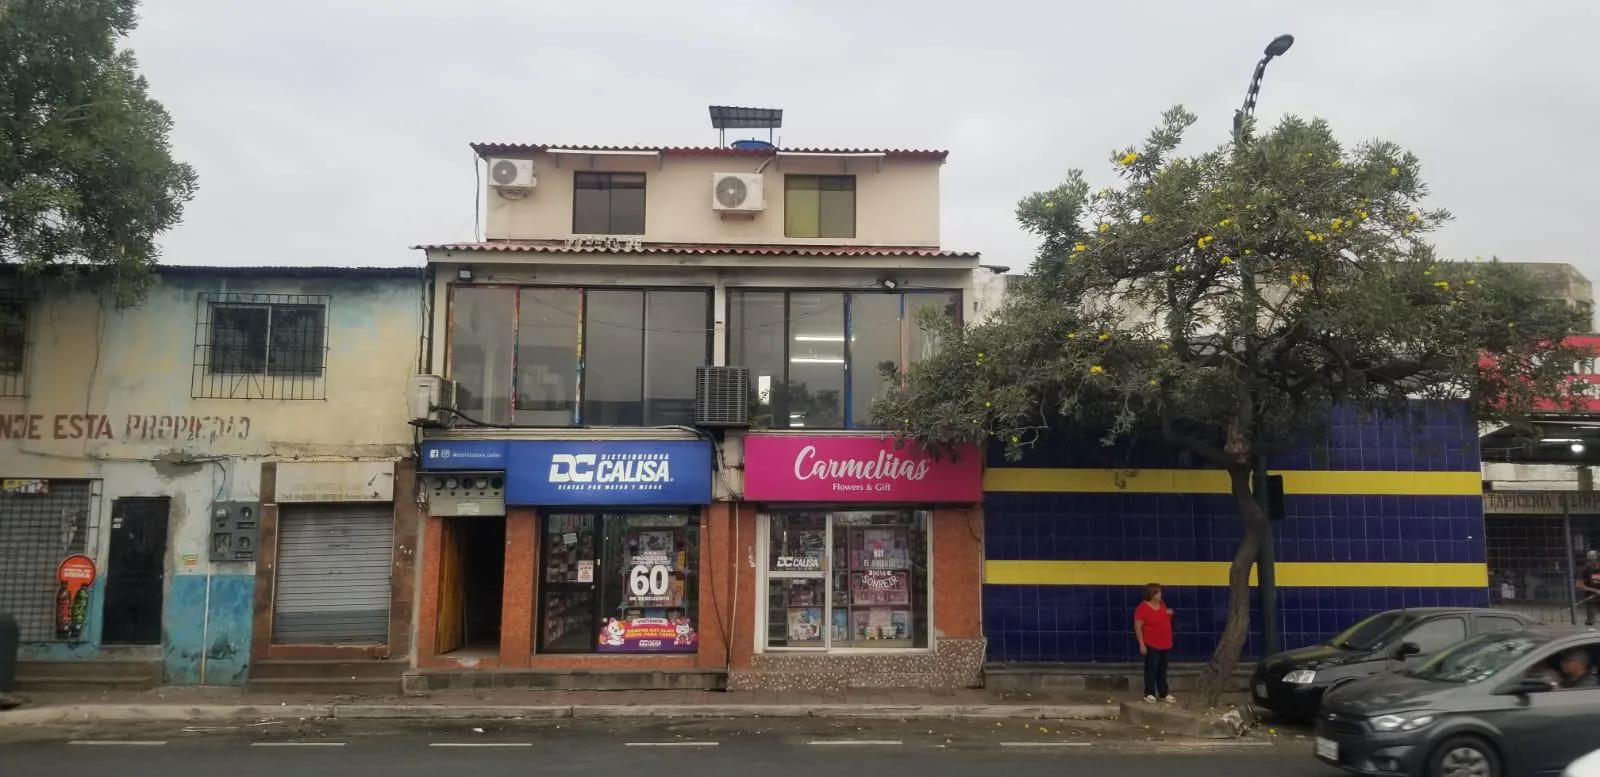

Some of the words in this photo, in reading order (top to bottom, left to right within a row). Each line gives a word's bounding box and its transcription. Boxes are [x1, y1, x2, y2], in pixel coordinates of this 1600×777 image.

[53, 414, 113, 439] ESTA
[549, 454, 597, 482] DC
[597, 460, 670, 482] CALISA
[794, 445, 930, 480] Carmelitas
[832, 483, 864, 491] Flowers
[875, 483, 892, 491] Gift
[1487, 494, 1552, 507] TAPICERIA
[777, 556, 793, 567] DC
[793, 559, 818, 567] CALISA
[630, 564, 669, 596] 60
